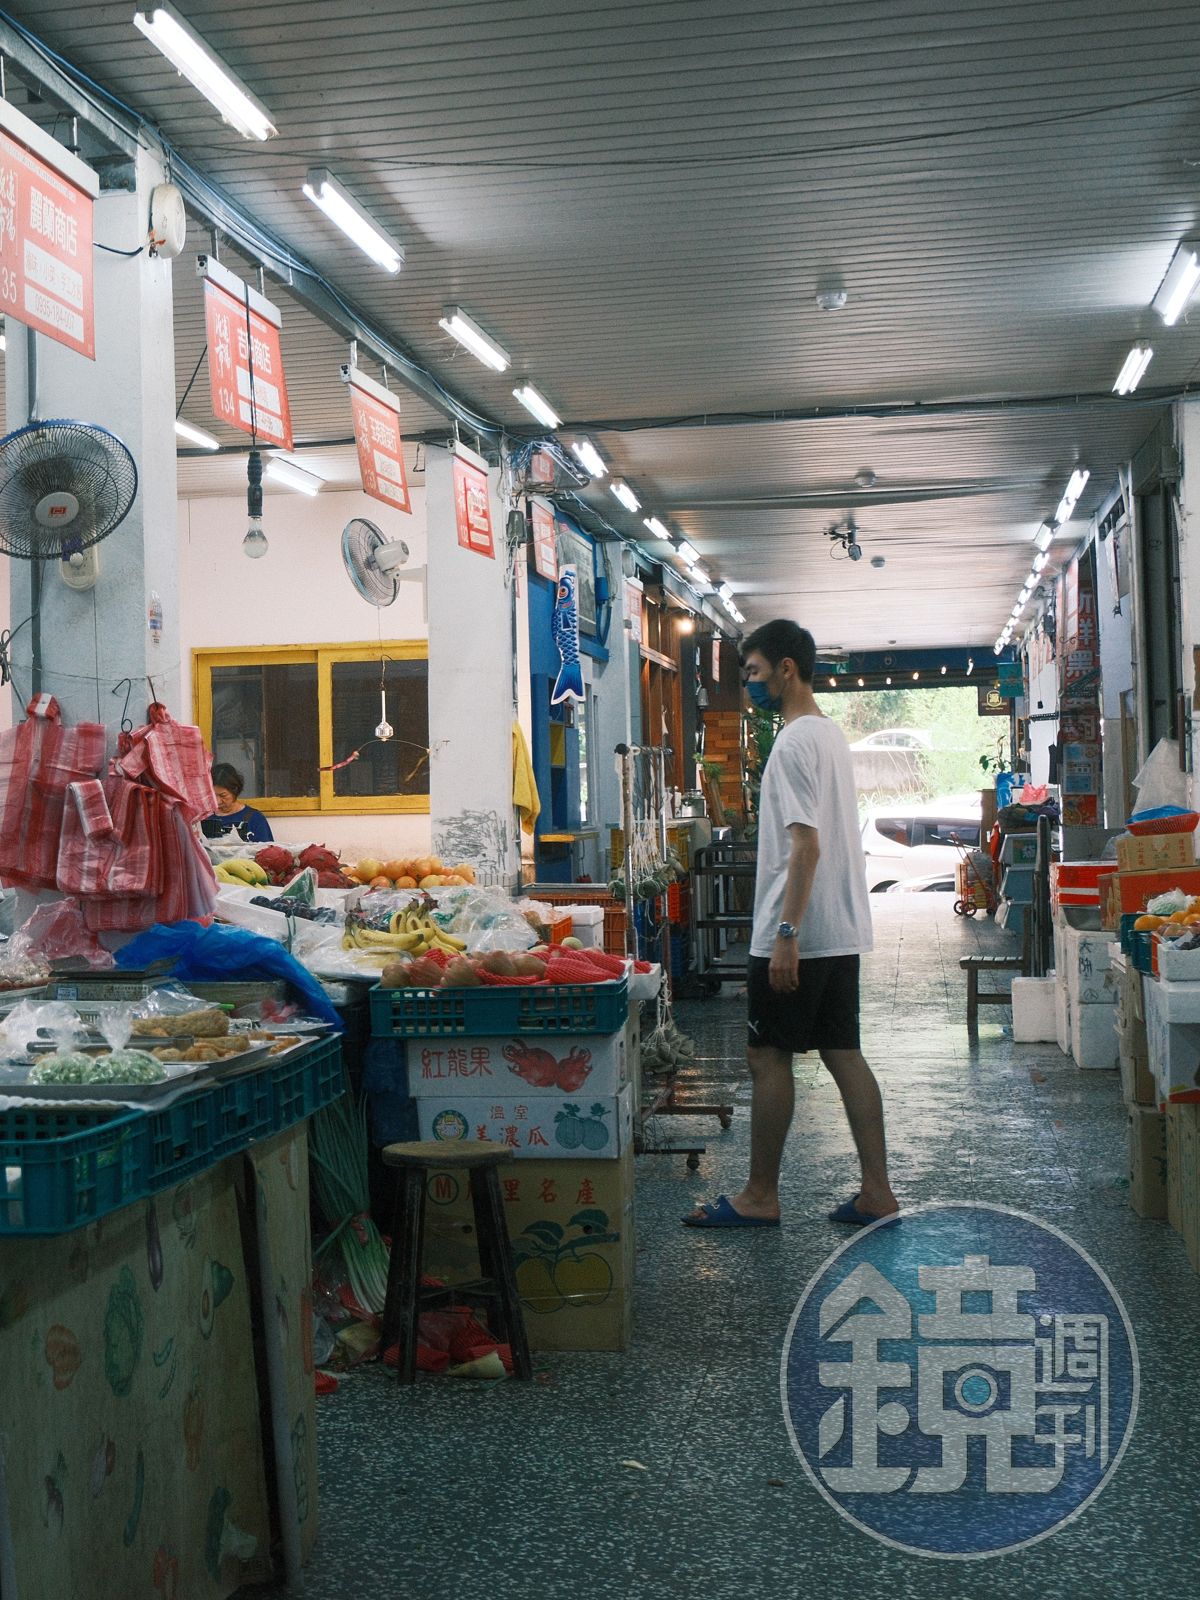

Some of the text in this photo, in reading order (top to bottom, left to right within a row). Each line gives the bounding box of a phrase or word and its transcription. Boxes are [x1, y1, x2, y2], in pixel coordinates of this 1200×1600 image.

[30, 186, 77, 256] 麗蘭商店
[219, 387, 235, 417] 134
[421, 1047, 493, 1080] 紅龍果
[467, 1178, 596, 1206] 里名產
